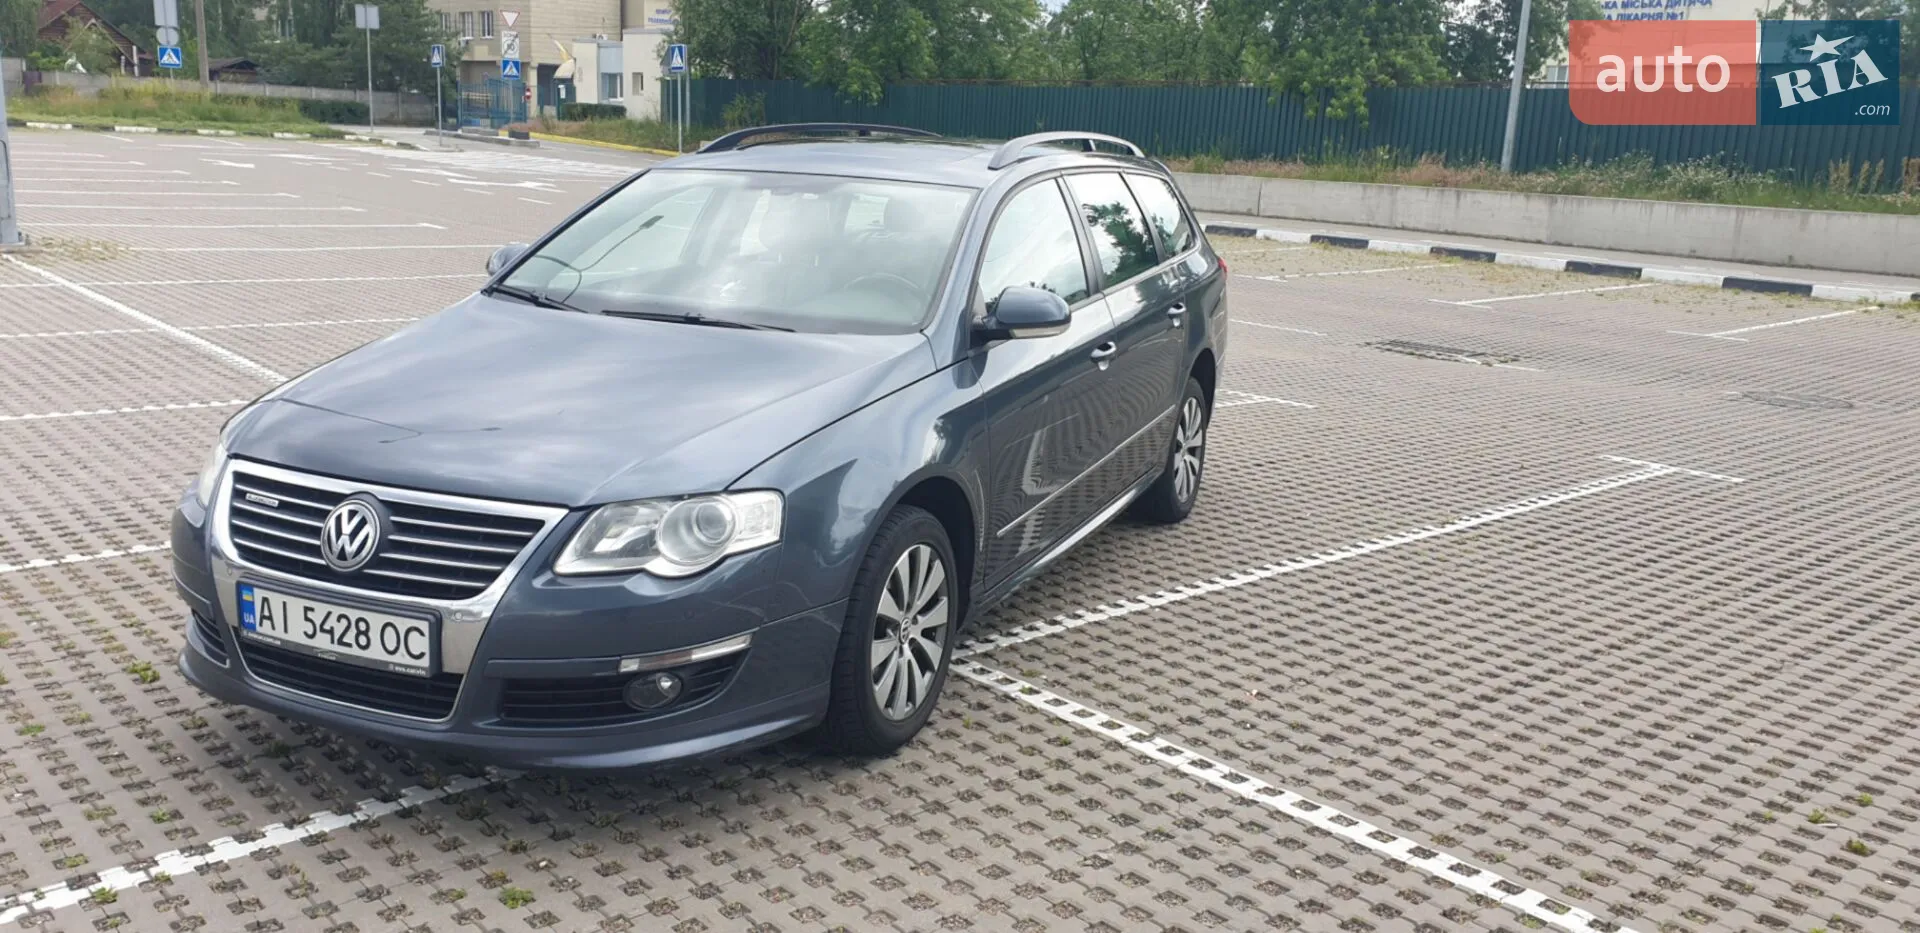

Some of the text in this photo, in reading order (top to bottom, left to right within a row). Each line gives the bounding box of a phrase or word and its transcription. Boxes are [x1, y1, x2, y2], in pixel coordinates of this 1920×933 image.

[244, 613, 256, 626] UA
[258, 596, 427, 661] AI 5428 OC
